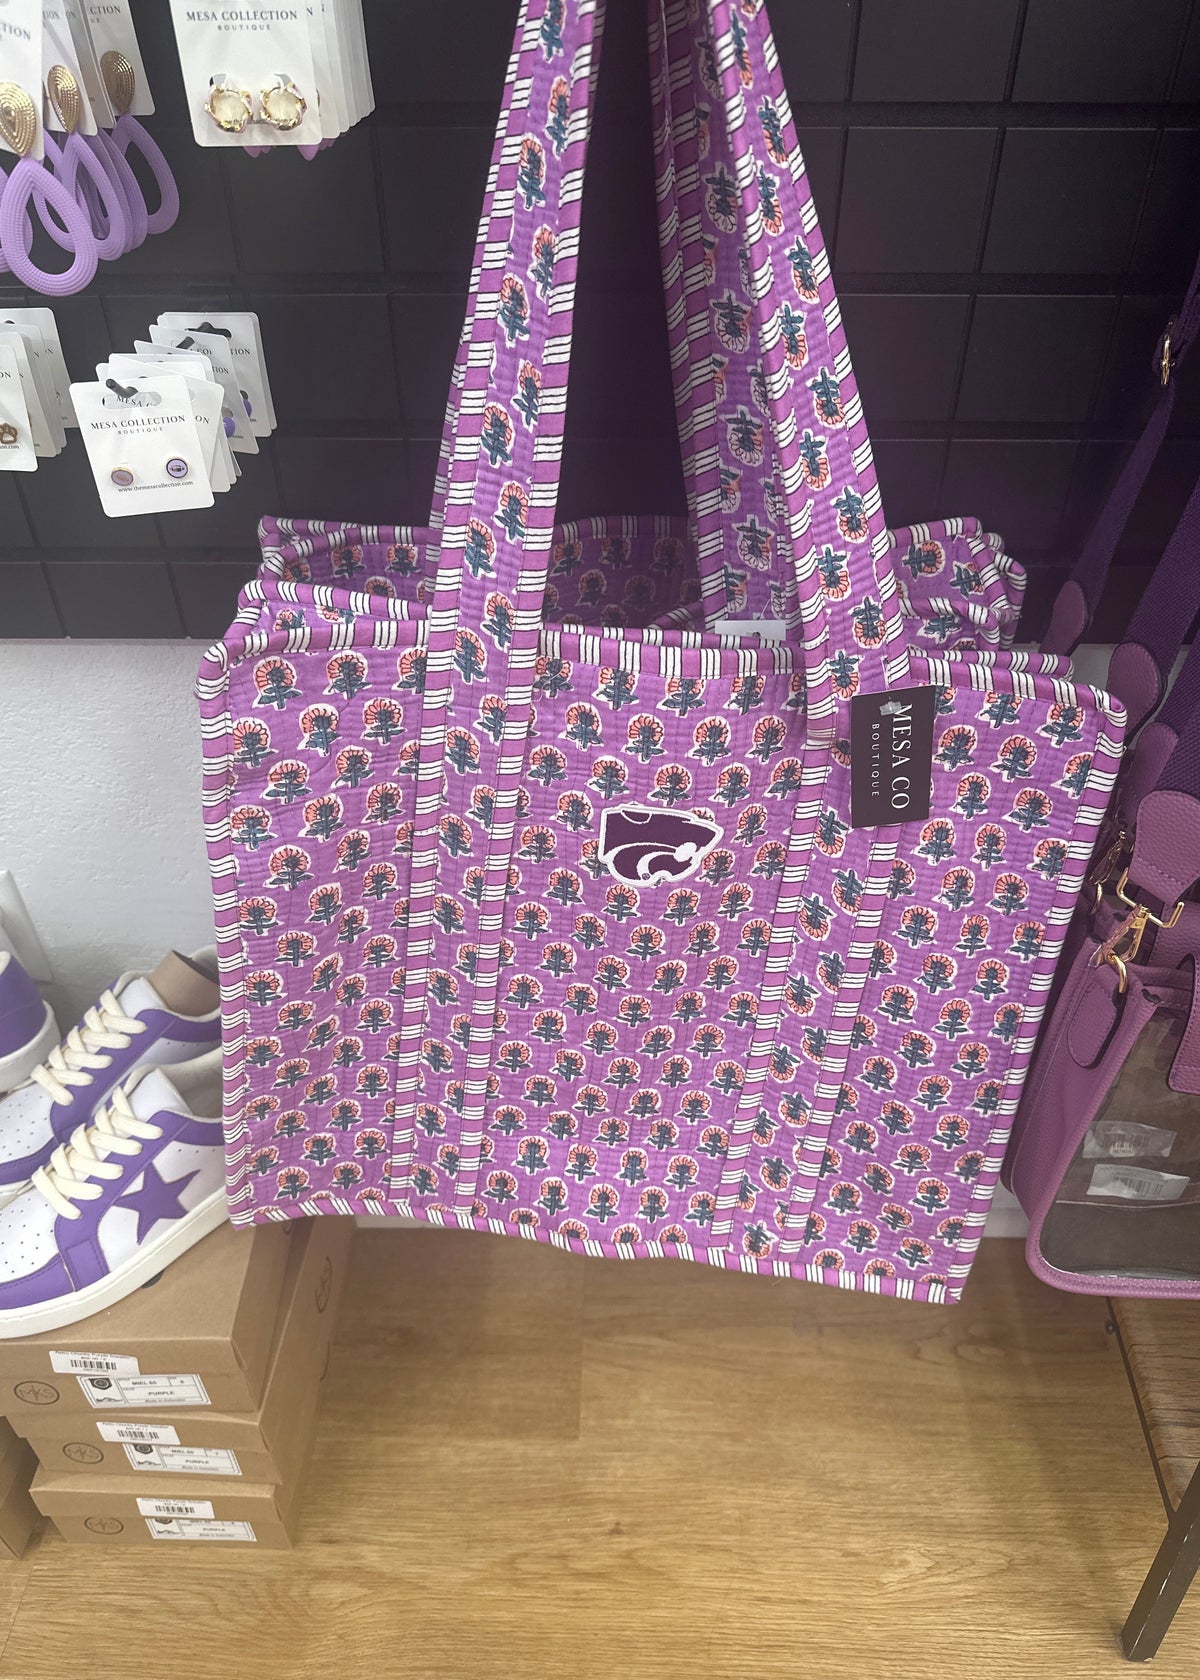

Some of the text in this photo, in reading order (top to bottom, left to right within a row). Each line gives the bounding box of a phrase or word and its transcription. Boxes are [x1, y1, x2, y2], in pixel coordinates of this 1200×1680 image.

[186, 11, 218, 22] MESA
[222, 10, 298, 21] COLLECTION
[90, 421, 118, 430] MESA
[120, 415, 186, 428] COLLECTION
[117, 427, 164, 435] BOUTIQUE
[871, 723, 880, 797] BOUTIQUE
[891, 703, 913, 809] MESA CO
